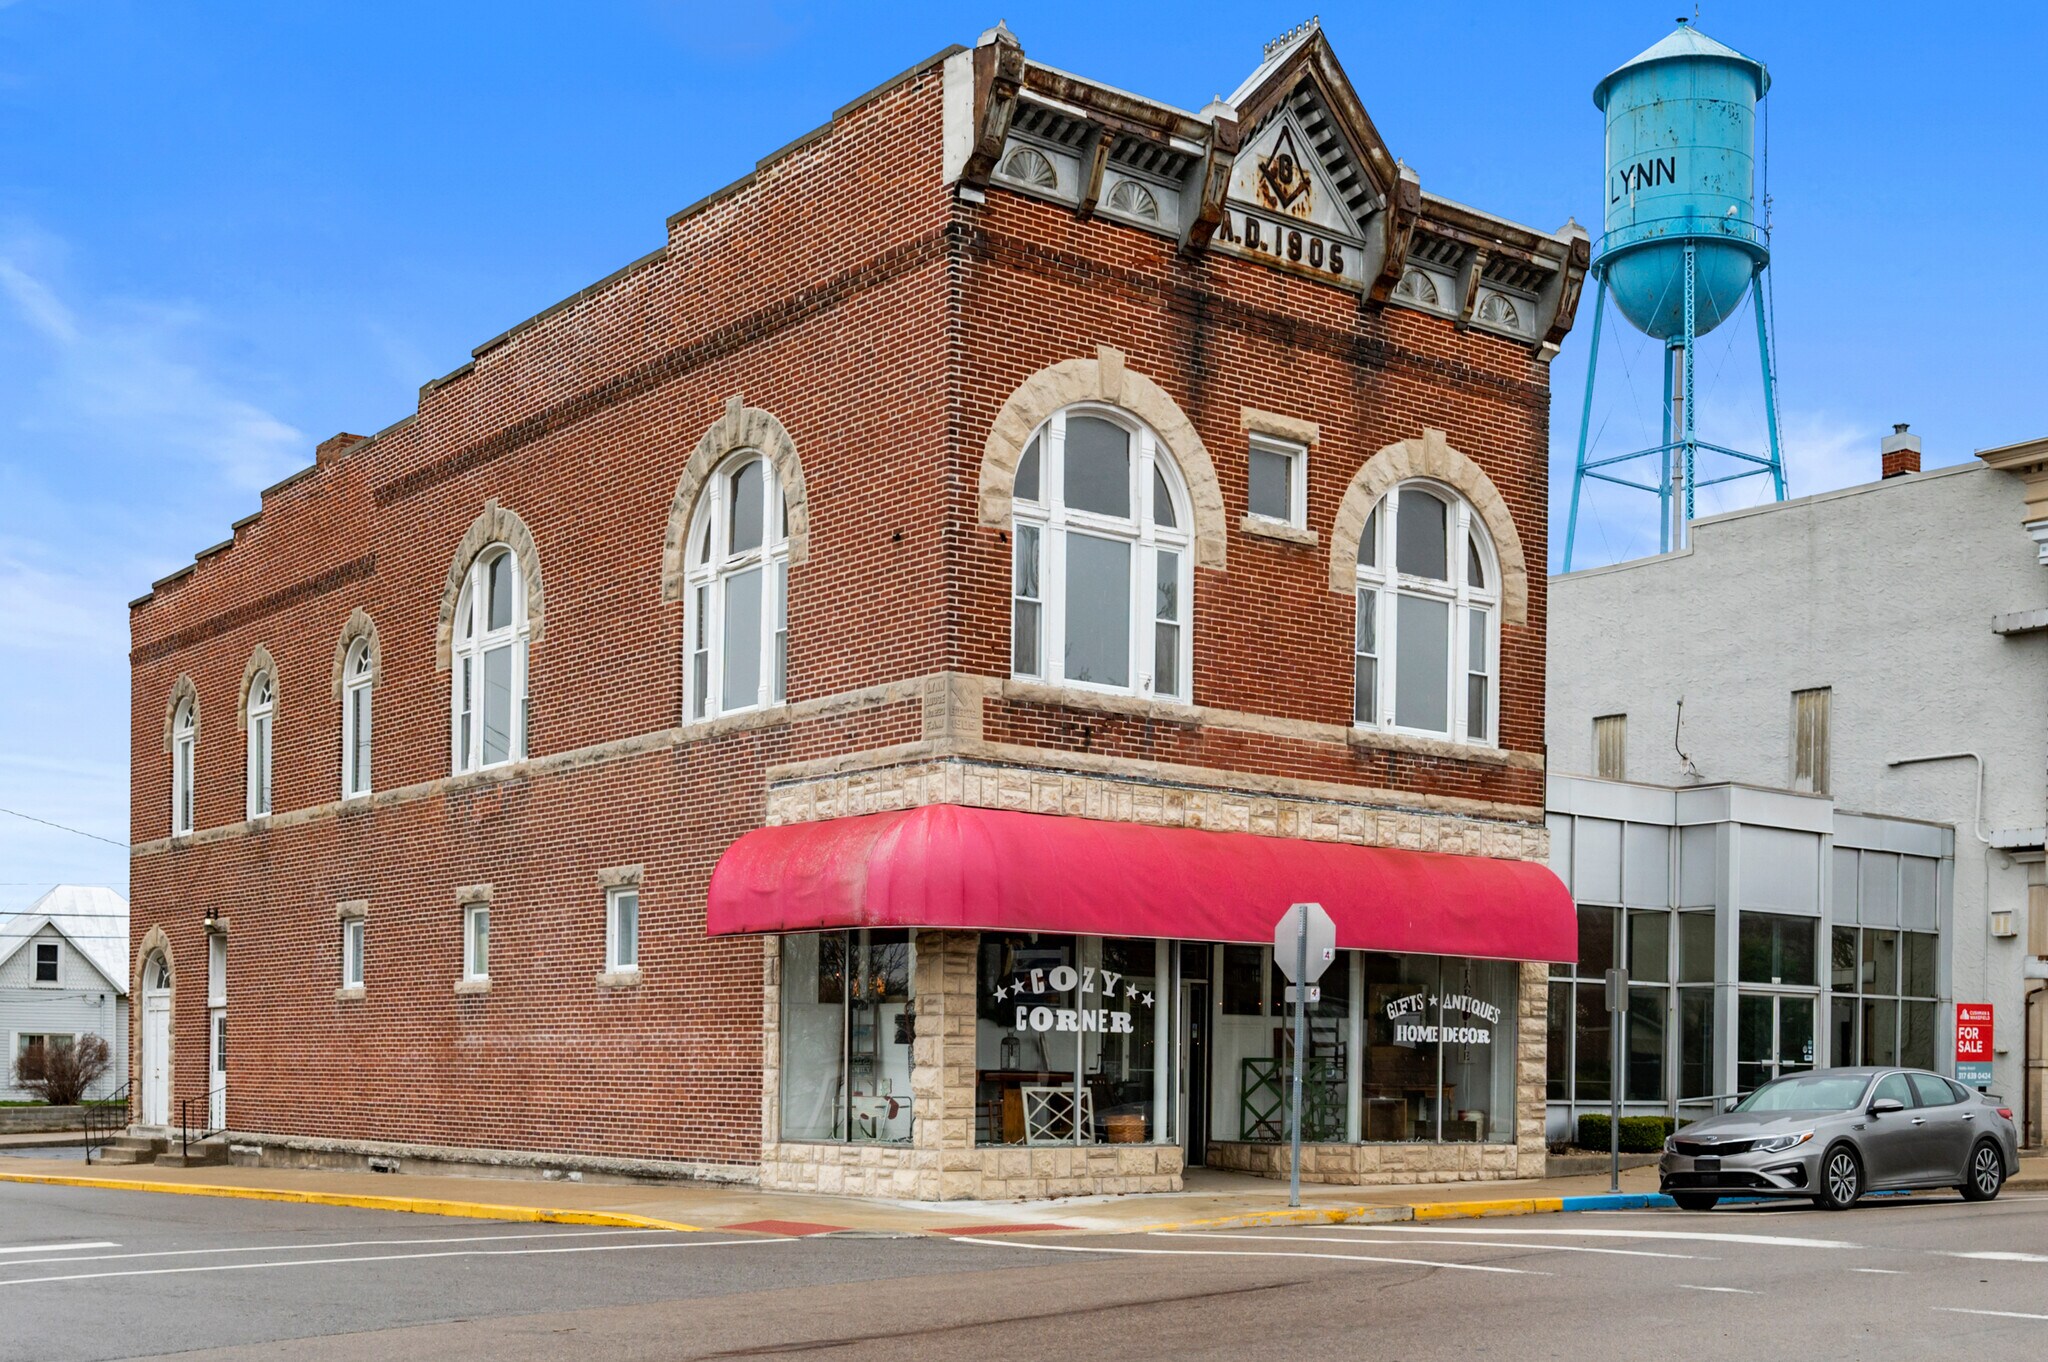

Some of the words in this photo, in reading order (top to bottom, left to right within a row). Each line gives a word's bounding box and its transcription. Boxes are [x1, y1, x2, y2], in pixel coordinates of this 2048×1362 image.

[1611, 156, 1675, 205] LYNN
[1030, 965, 1122, 998] COZY
[1016, 1005, 1134, 1034] CORNER
[1386, 992, 1423, 1020] GIFTS
[1442, 993, 1501, 1025] ANTIQUES
[1396, 1024, 1438, 1043] HOME
[1442, 1026, 1491, 1044] DECOR
[1958, 1027, 1979, 1039] FOR
[1958, 1040, 1983, 1053] SALE
